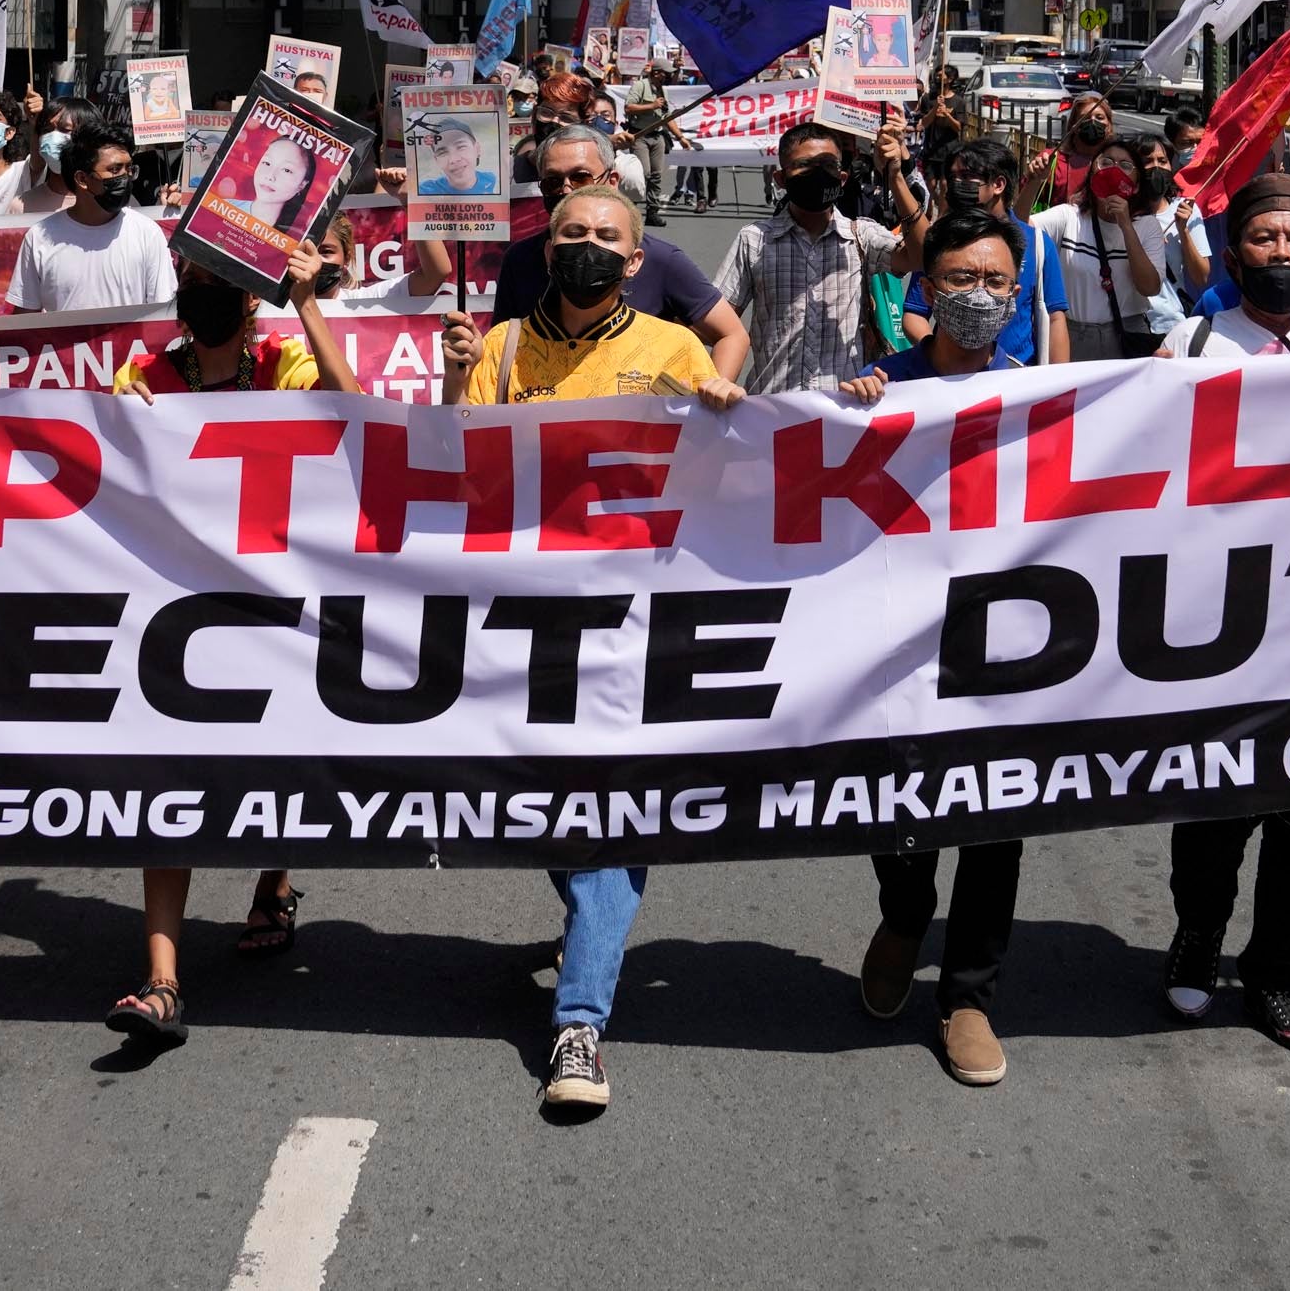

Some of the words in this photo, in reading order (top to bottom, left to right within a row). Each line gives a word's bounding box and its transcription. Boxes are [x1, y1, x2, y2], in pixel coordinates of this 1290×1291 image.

[275, 43, 334, 61] HUSTISYA!
[428, 46, 474, 57] HUSTISYA!
[128, 58, 185, 72] HUSTISYA!
[96, 70, 129, 94] STO
[403, 89, 504, 109] HUSTISYA!
[701, 92, 775, 117] STOP
[785, 87, 818, 110] TH
[134, 124, 161, 133] FRANCIS
[186, 113, 235, 128] HUSTISY
[252, 107, 344, 165] HUSTISYA!
[406, 135, 443, 146] STOP
[425, 212, 455, 221] DELOS
[456, 212, 495, 221] SANTOS
[435, 204, 457, 213] KIAN
[459, 204, 484, 213] LOYD
[207, 199, 249, 229] ANGEL
[252, 222, 288, 249] RIVAS
[424, 223, 457, 231] AUGUST
[458, 223, 472, 232] 16,
[474, 223, 495, 231] 2017
[514, 384, 556, 401] adidas
[189, 418, 684, 554] THE
[228, 786, 728, 840] ALYANSANG
[758, 737, 1255, 829] MAKABAYAN
